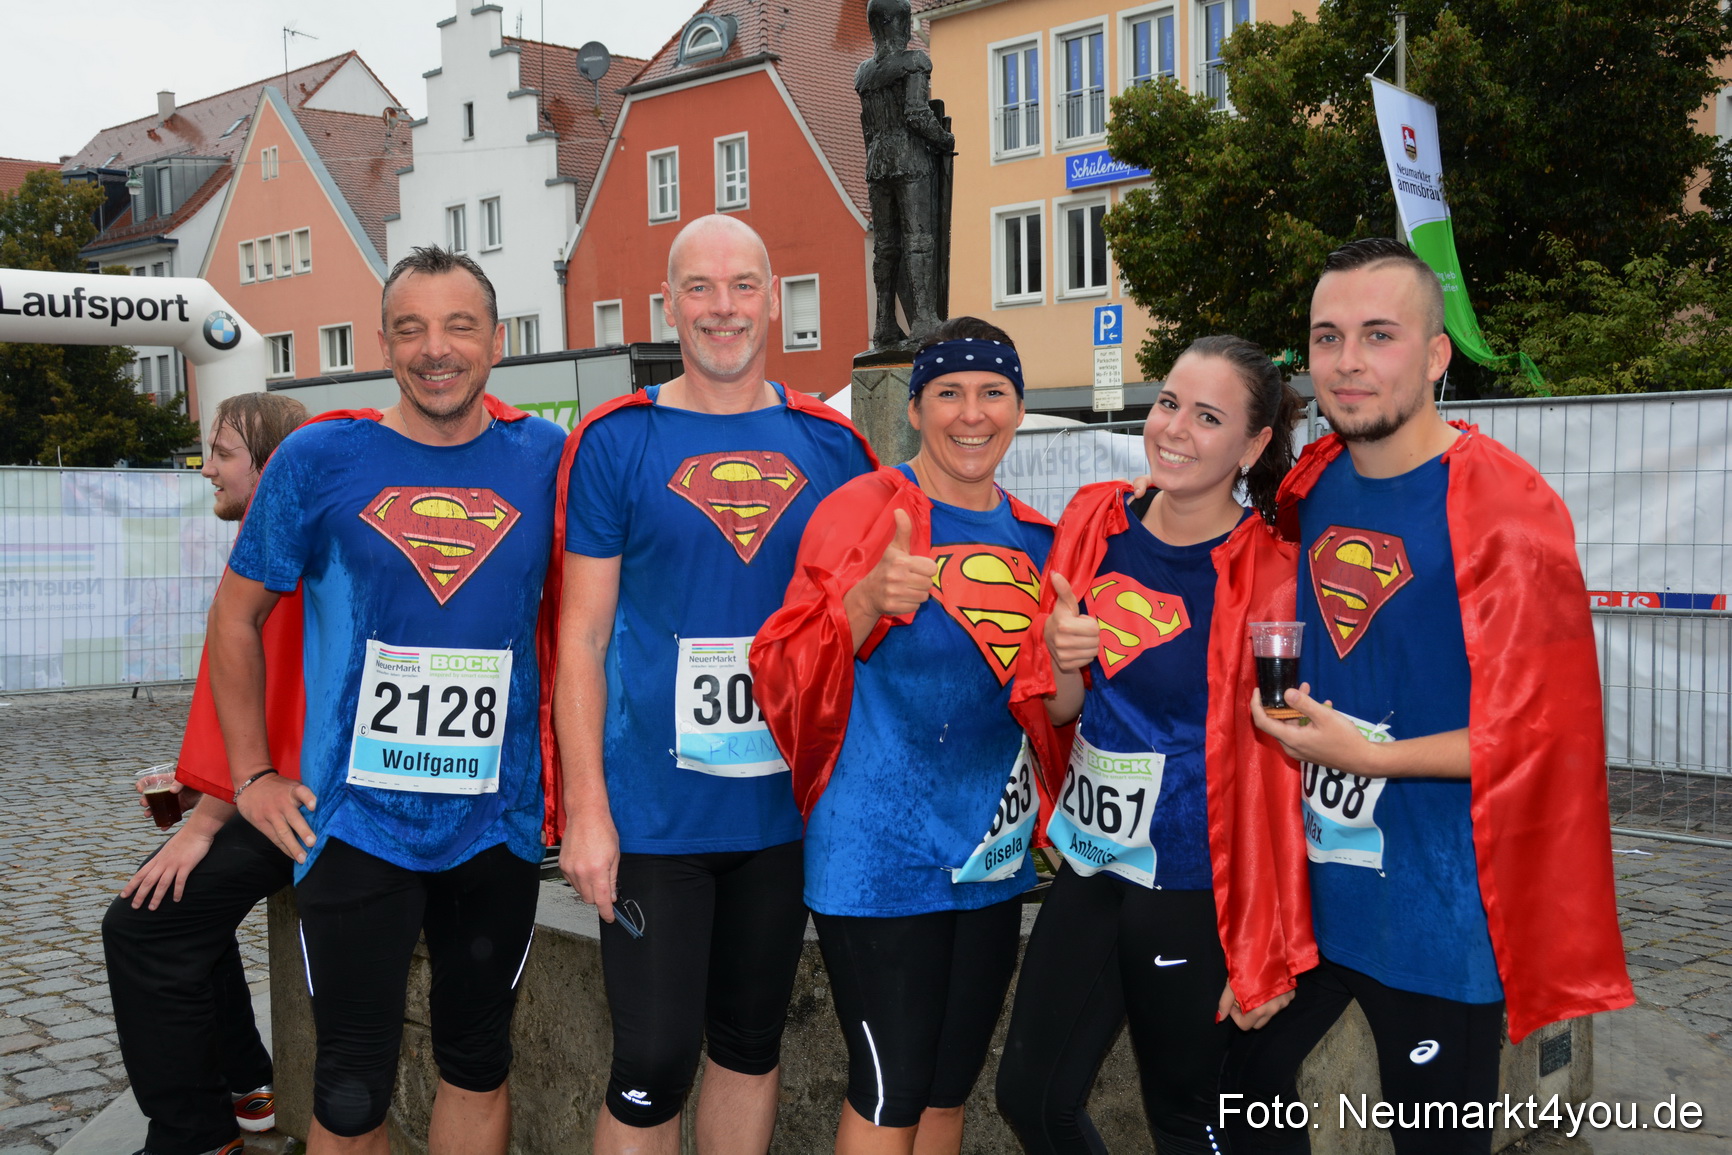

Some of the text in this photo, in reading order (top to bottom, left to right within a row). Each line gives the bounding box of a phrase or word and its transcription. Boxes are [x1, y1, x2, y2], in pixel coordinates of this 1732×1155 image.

[1396, 163, 1431, 182] Neumarkter
[1397, 179, 1440, 201] ammsbräu
[0, 286, 190, 327] Laufsport
[376, 659, 421, 672] NeuerMarkt
[430, 654, 499, 672] BOCK
[689, 655, 736, 663] NeuerMarkt
[370, 681, 496, 739] 2128
[693, 673, 777, 726] 30
[382, 748, 479, 778] Wolfgang
[1087, 749, 1152, 775] BOCK
[1062, 764, 1146, 839] 2061
[1303, 761, 1372, 819] 088
[985, 836, 1023, 871] Gisela
